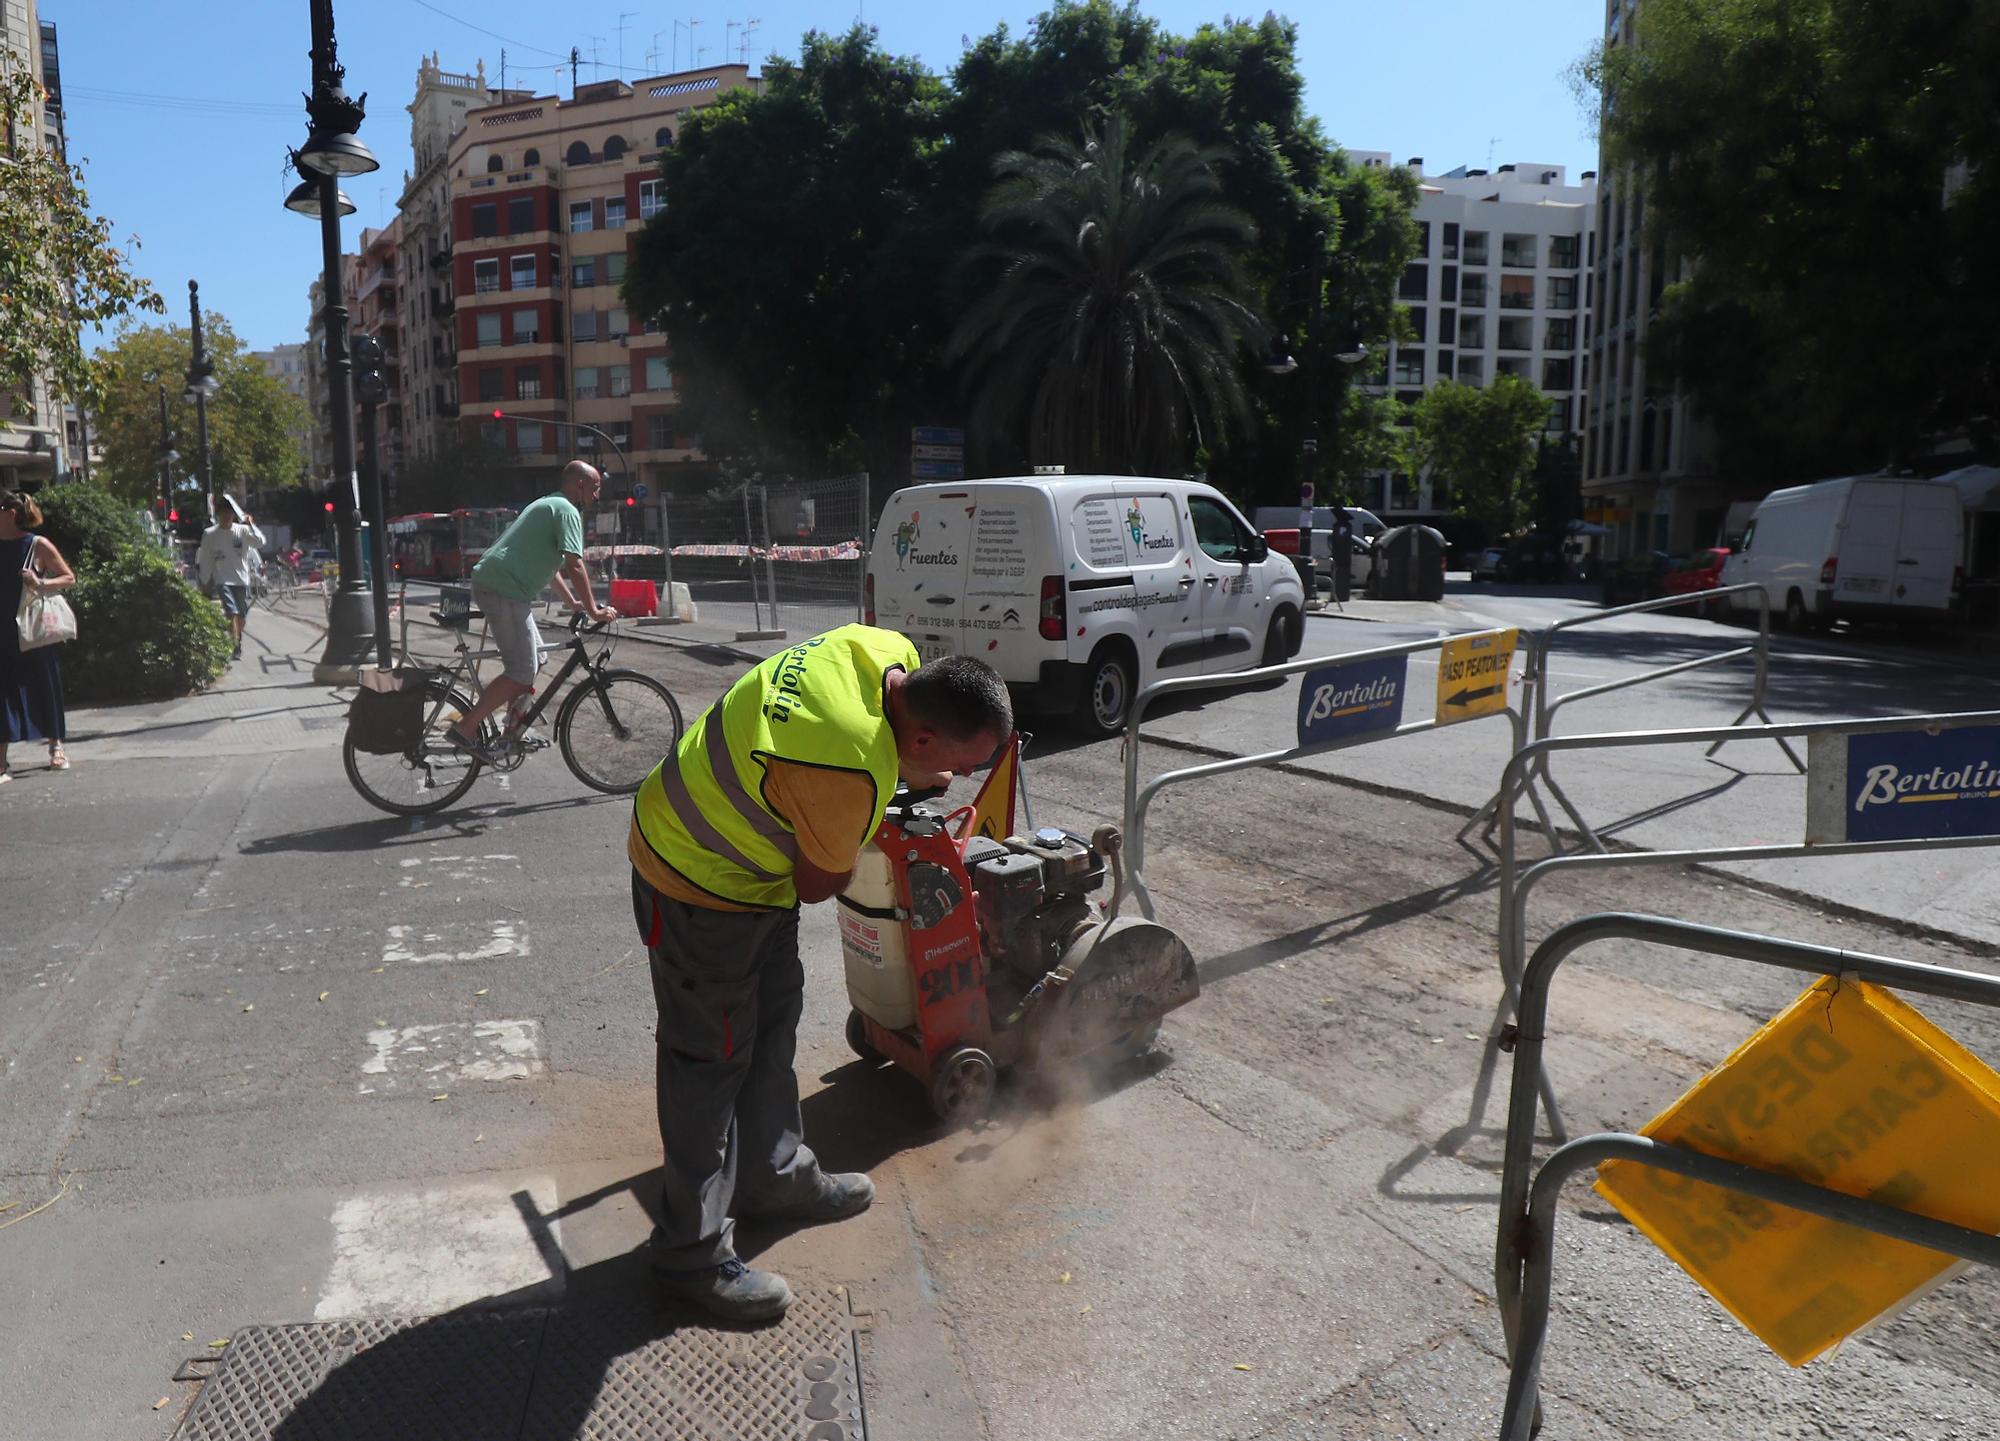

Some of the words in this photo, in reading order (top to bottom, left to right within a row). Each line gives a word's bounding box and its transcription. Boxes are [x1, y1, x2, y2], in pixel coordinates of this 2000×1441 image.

[909, 548, 958, 566] Fuentes
[1466, 652, 1510, 678] PEATONES
[1305, 676, 1397, 728] Bertolín
[1959, 791, 1988, 800] GRUPO
